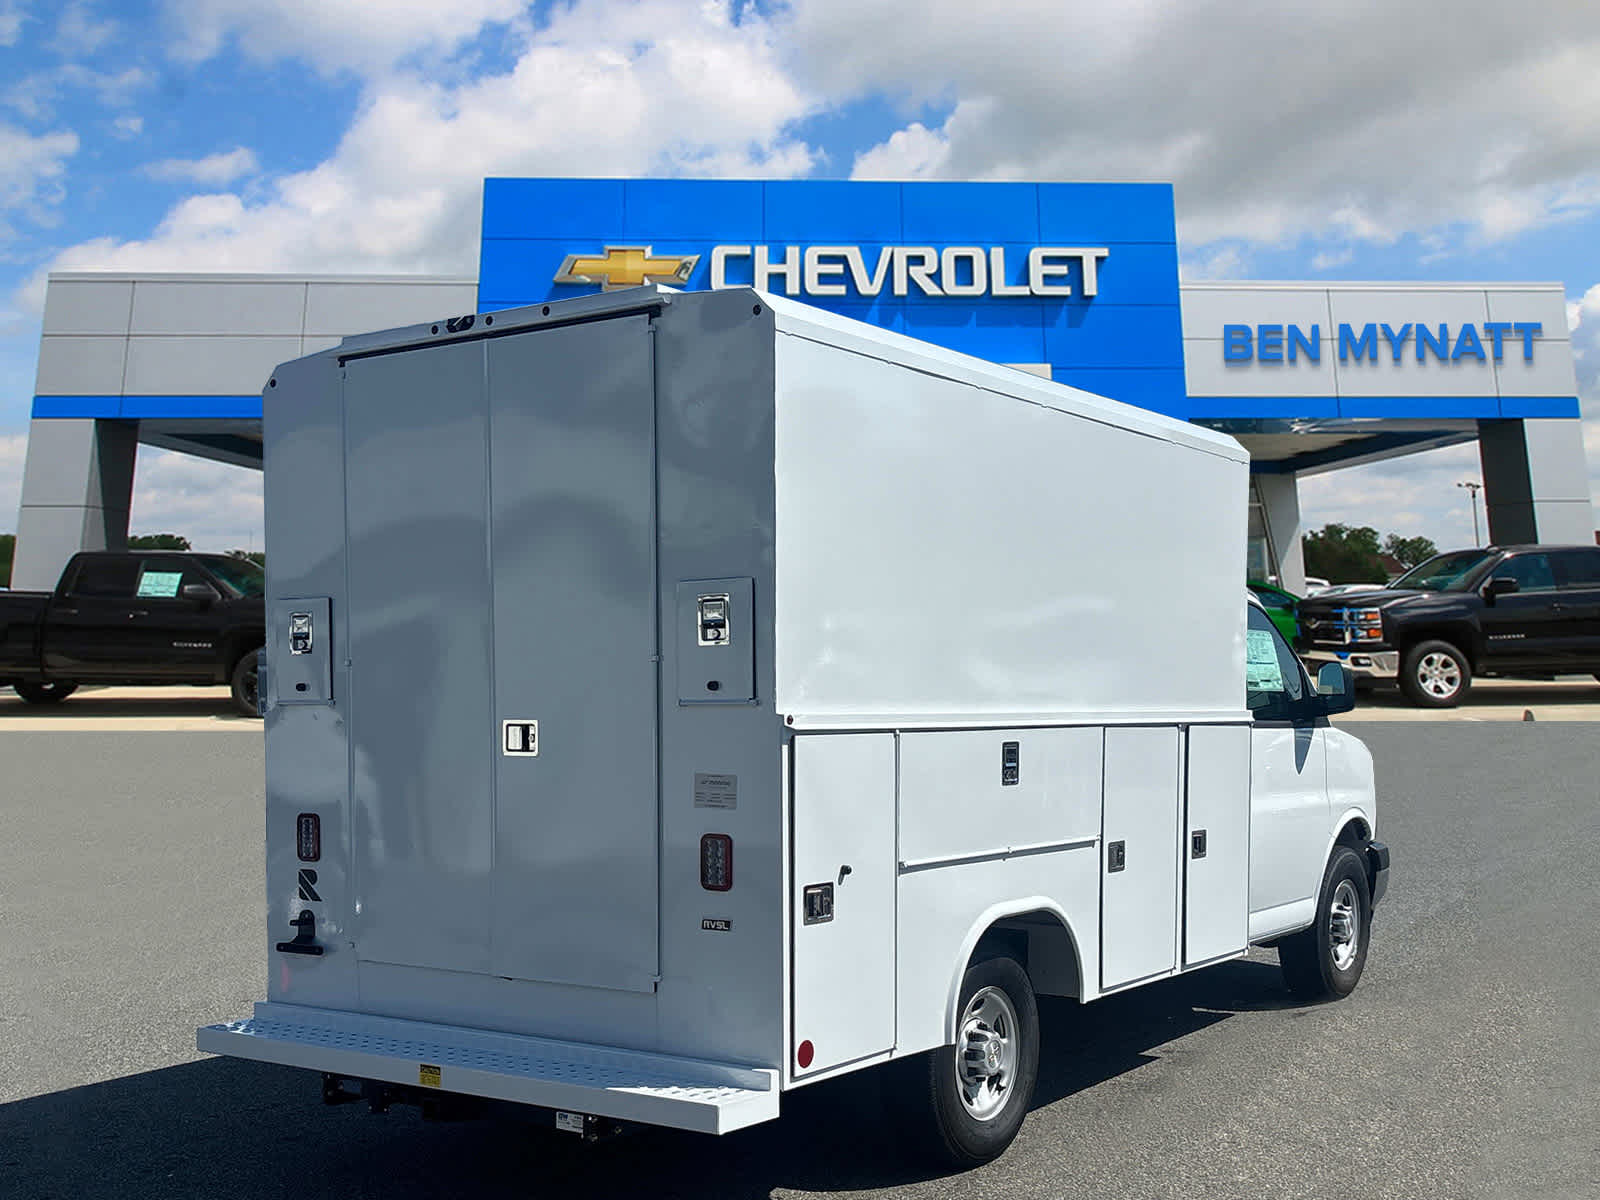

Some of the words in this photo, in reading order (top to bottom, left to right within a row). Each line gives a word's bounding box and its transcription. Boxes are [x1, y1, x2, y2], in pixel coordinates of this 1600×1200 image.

[711, 244, 1109, 297] CHEVROLET
[1223, 324, 1321, 362] BEN
[1339, 322, 1543, 362] MYNATT
